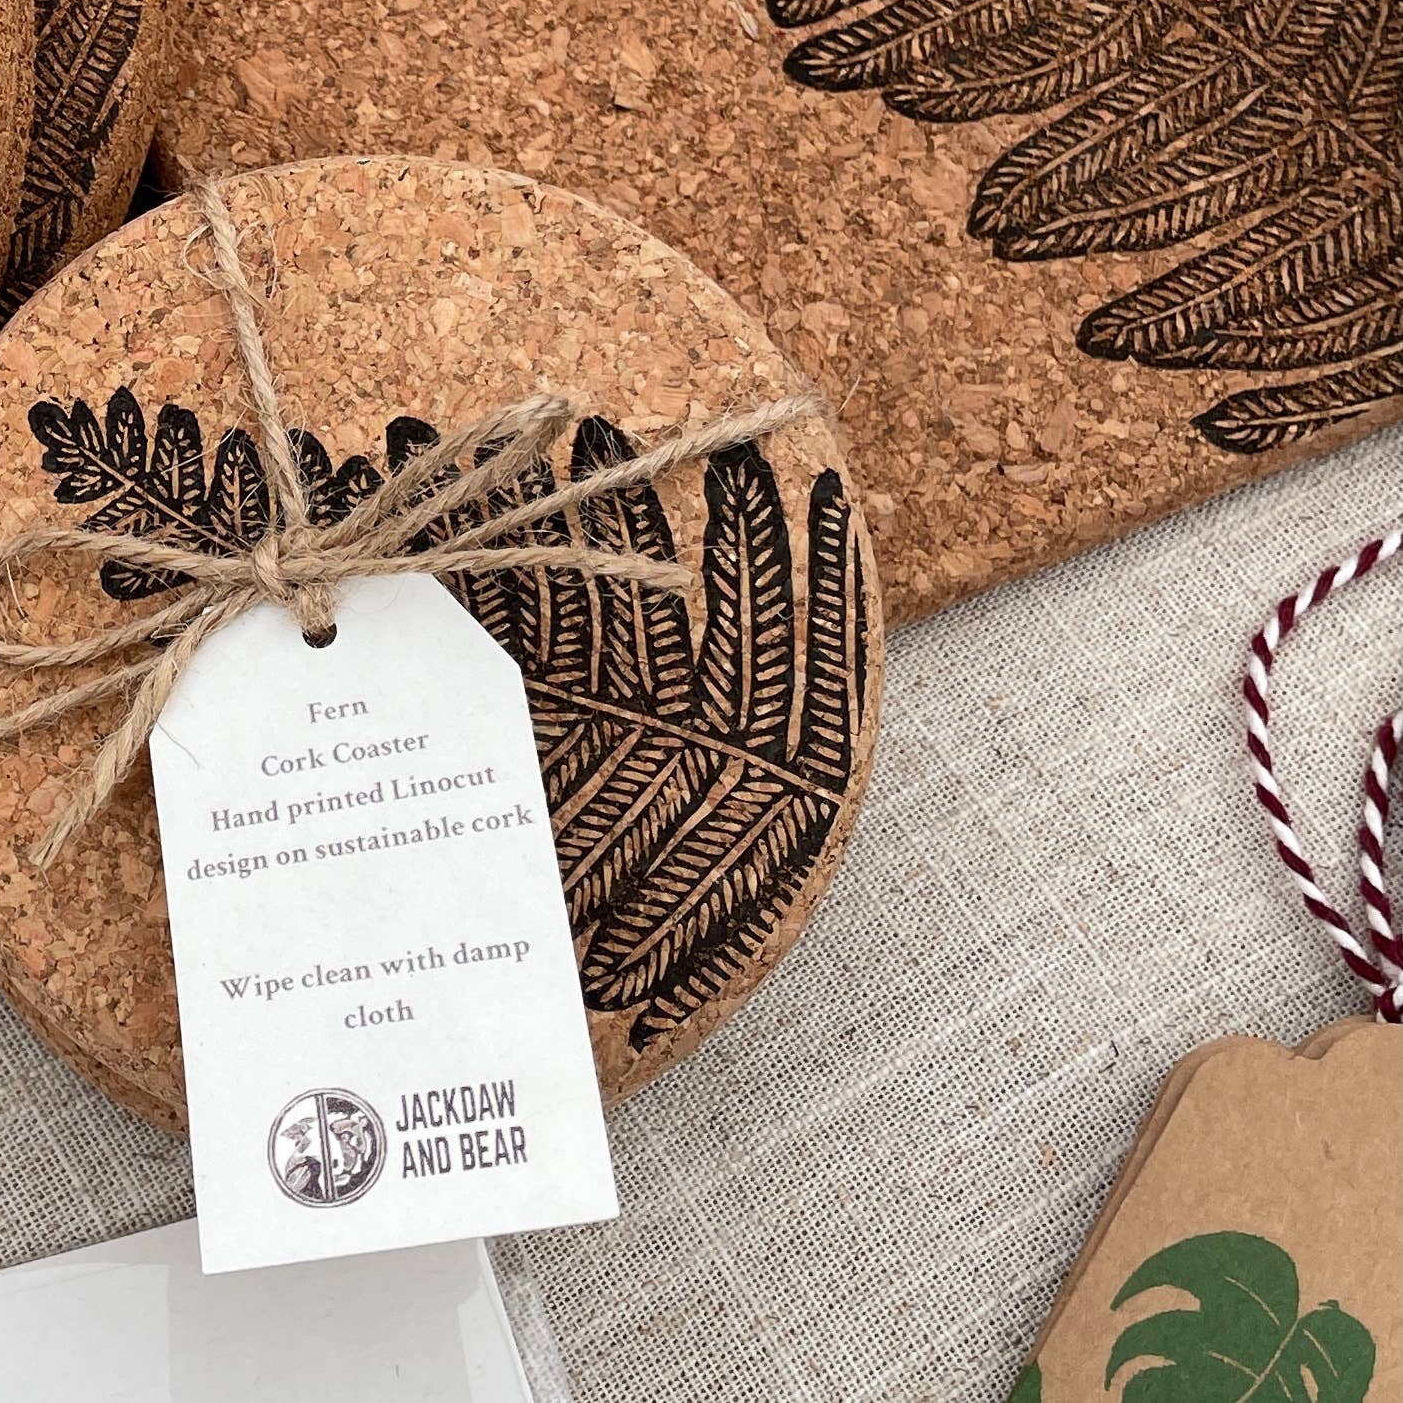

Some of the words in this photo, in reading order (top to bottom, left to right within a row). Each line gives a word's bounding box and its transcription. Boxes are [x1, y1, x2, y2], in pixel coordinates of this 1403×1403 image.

[306, 700, 371, 726] Fern
[260, 746, 328, 778] Cork
[332, 732, 431, 765] Coaster
[210, 798, 282, 834] Hand
[286, 781, 386, 827] printed
[390, 766, 498, 802] Linocut
[186, 853, 271, 882] design
[275, 847, 310, 867] on
[314, 815, 467, 860] sustainable
[471, 803, 536, 834] cork
[219, 973, 296, 1003] Wipe
[301, 962, 374, 990] clean
[378, 946, 448, 977] with
[452, 938, 533, 967] damp
[343, 998, 416, 1031] cloth
[395, 1079, 516, 1132] JACKDAW
[401, 1139, 451, 1179] AND
[460, 1126, 529, 1172] BEAR
